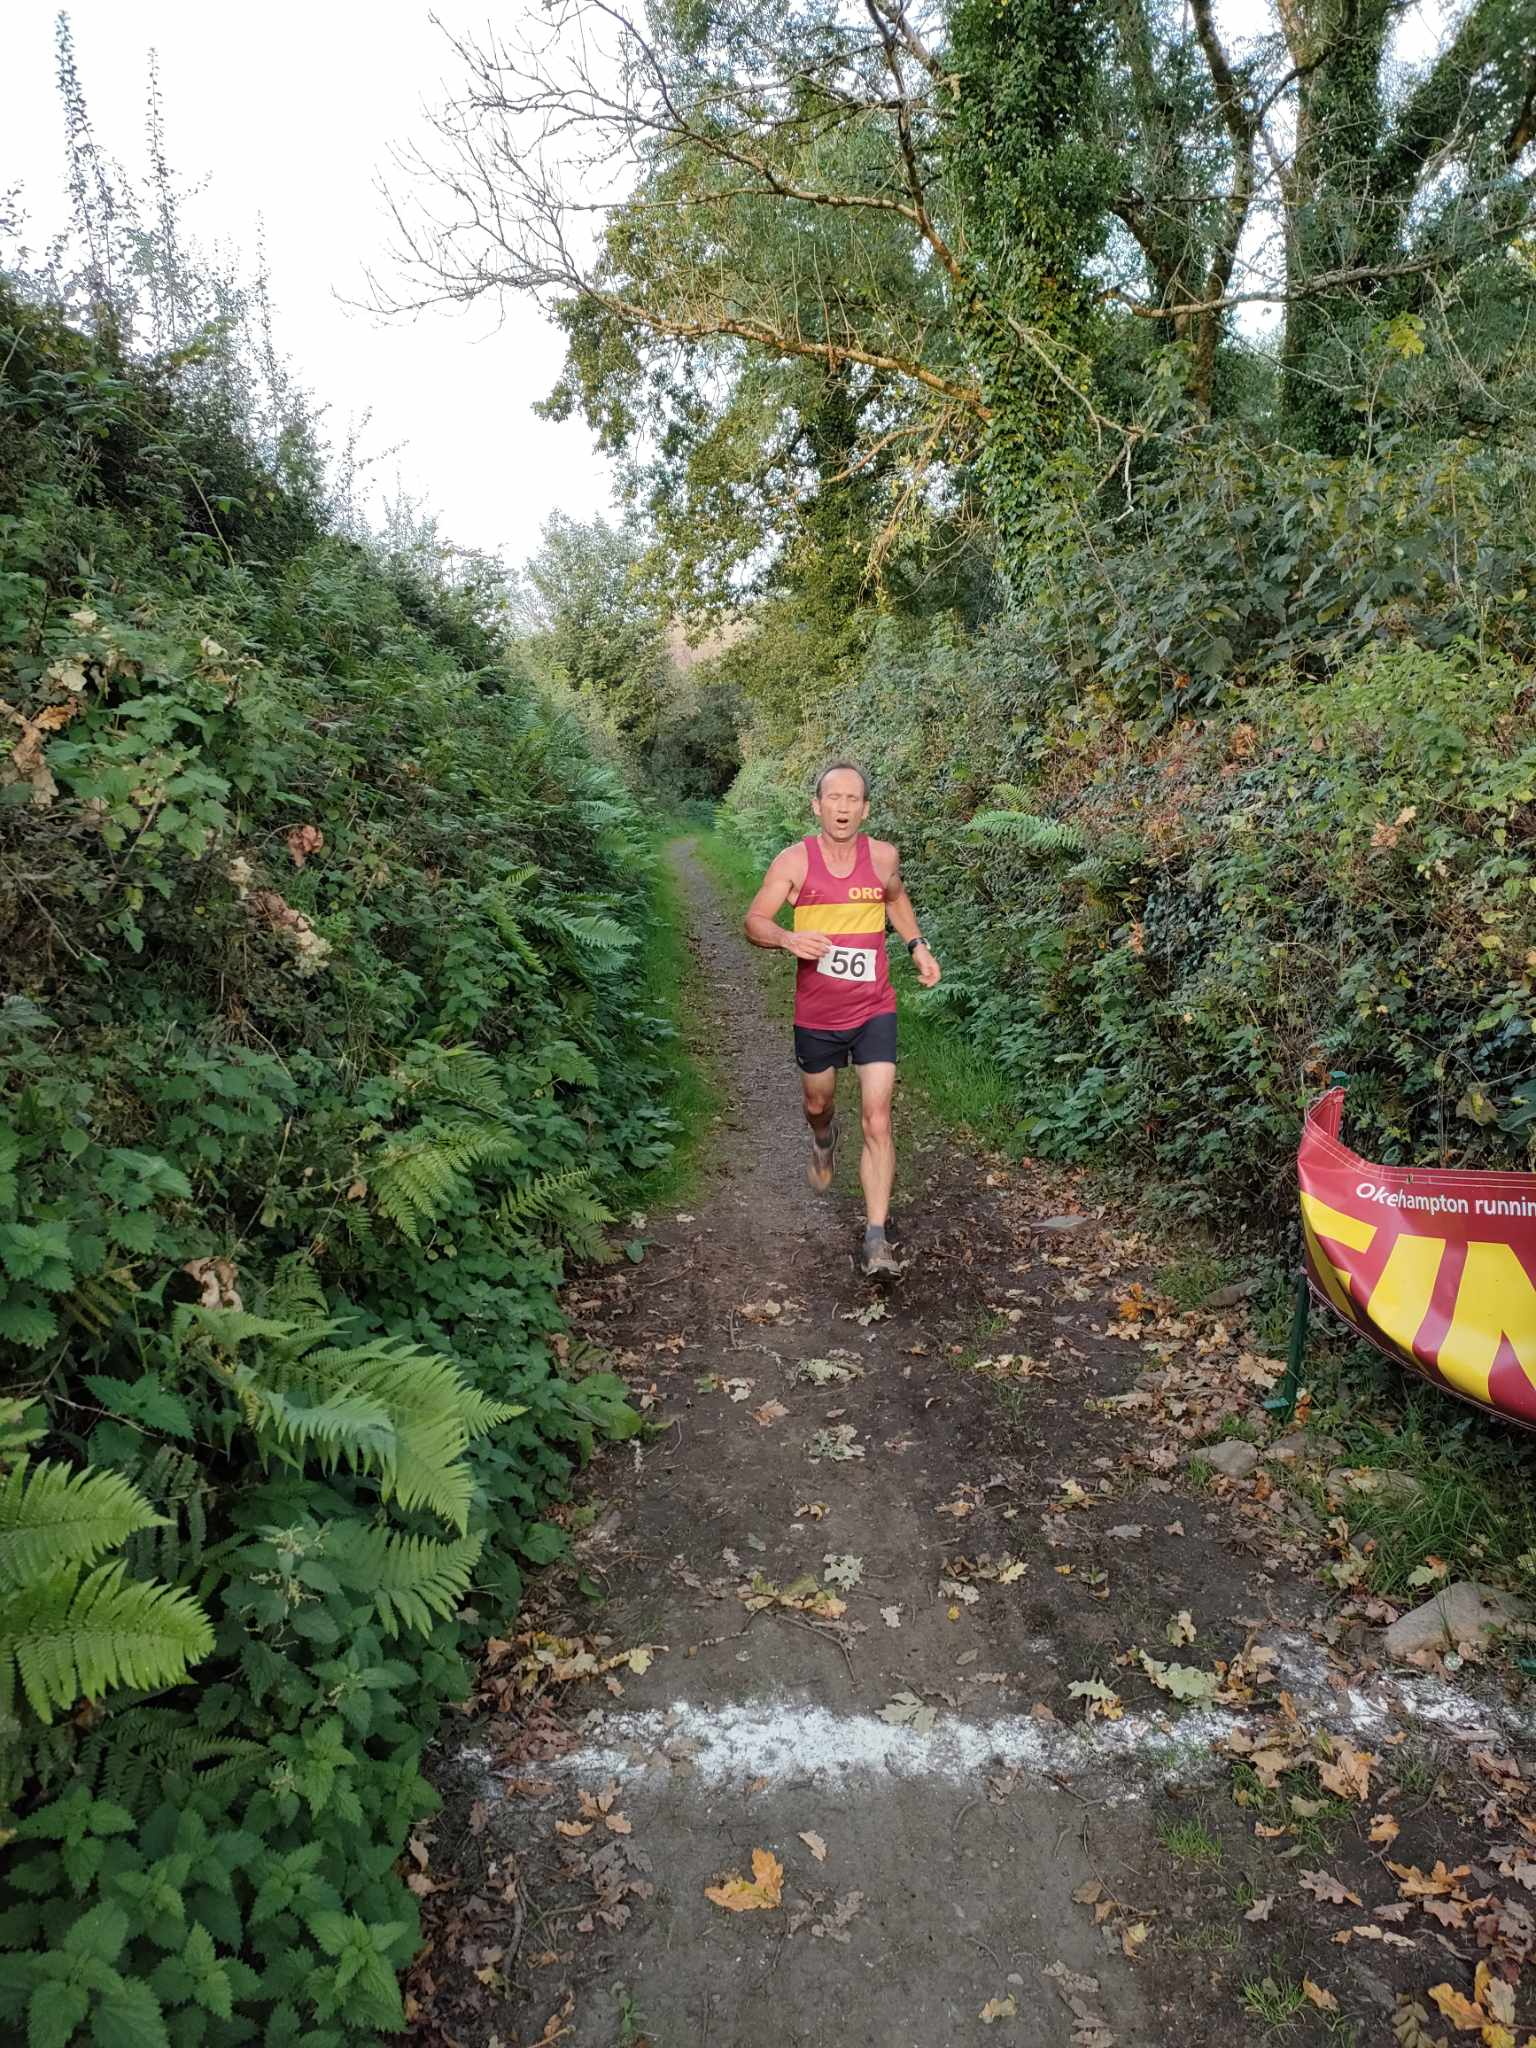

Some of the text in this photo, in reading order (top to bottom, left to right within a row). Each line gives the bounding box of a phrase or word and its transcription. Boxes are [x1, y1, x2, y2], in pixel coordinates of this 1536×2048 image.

[848, 887, 883, 899] ORC
[831, 950, 866, 977] 56
[1355, 1182, 1469, 1215] Okehampton
